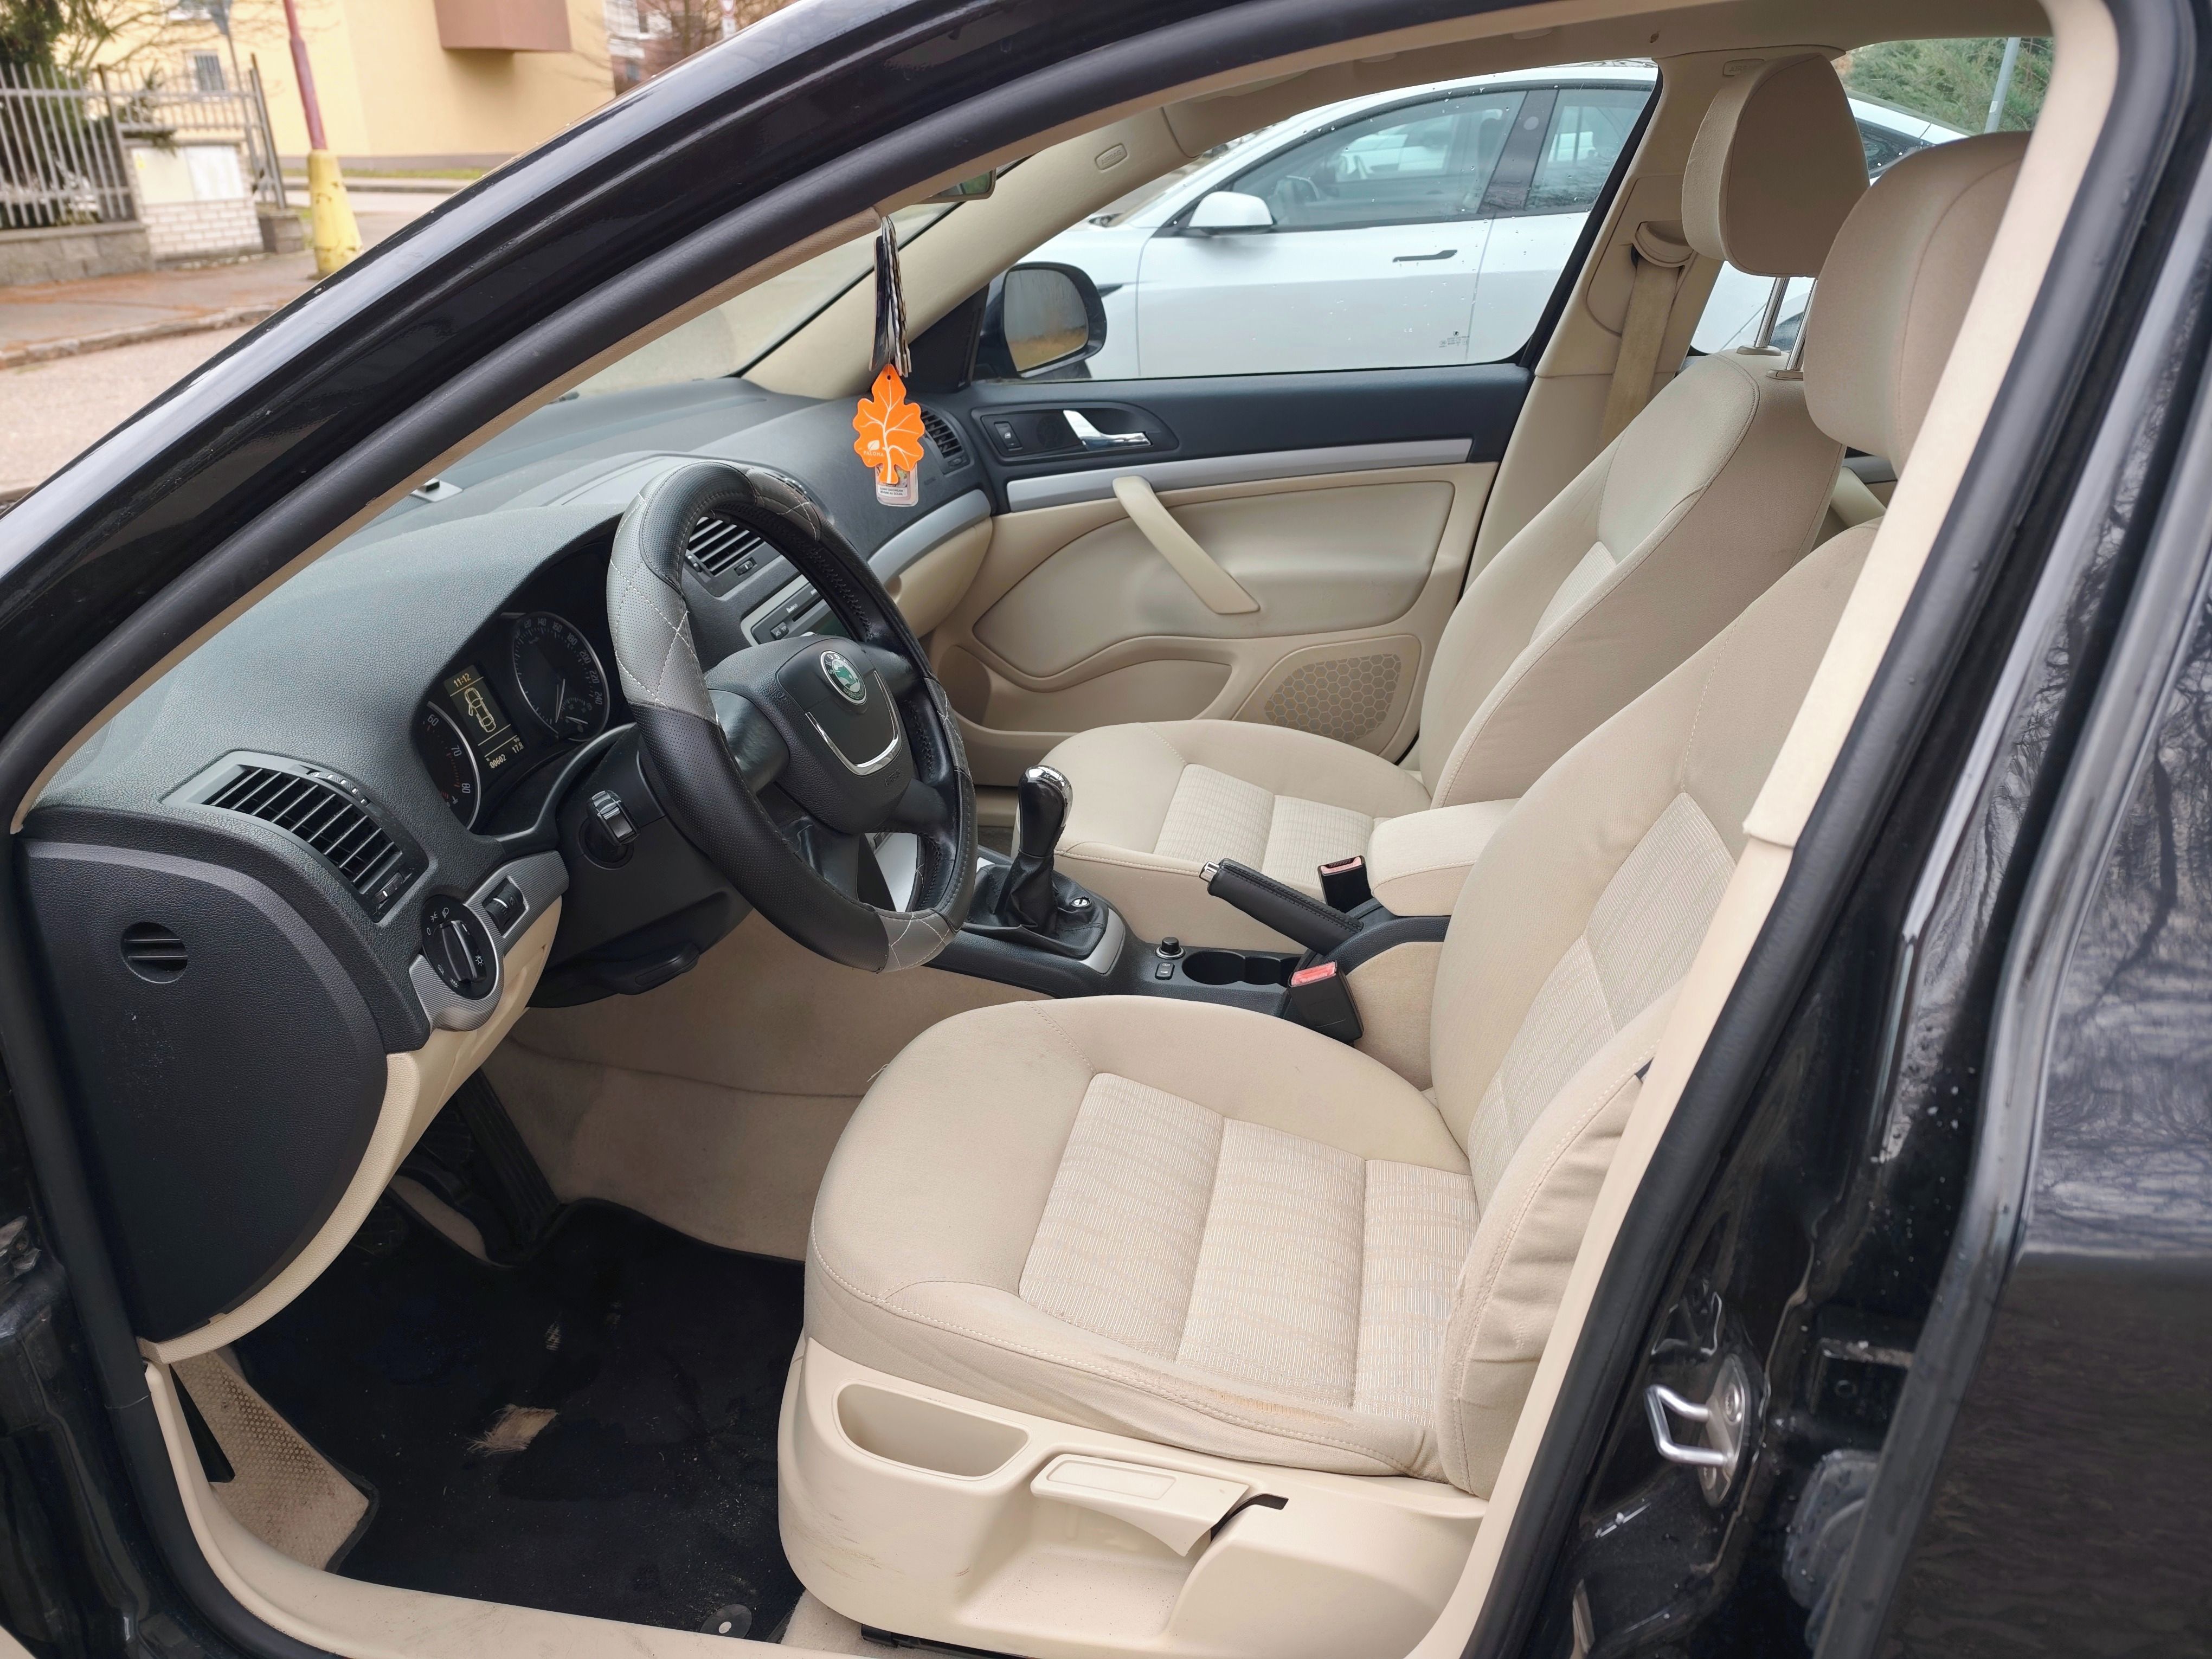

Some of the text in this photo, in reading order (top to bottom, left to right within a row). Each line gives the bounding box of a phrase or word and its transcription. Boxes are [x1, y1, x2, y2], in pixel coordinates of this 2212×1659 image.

[567, 633, 578, 646] 180
[579, 650, 591, 664] 200
[453, 673, 472, 687] 11:12
[589, 670, 600, 684] 220
[594, 691, 603, 705] 240
[427, 714, 439, 726] 60
[451, 744, 462, 757] 70
[488, 754, 507, 769] 00602
[461, 782, 471, 794] 80
